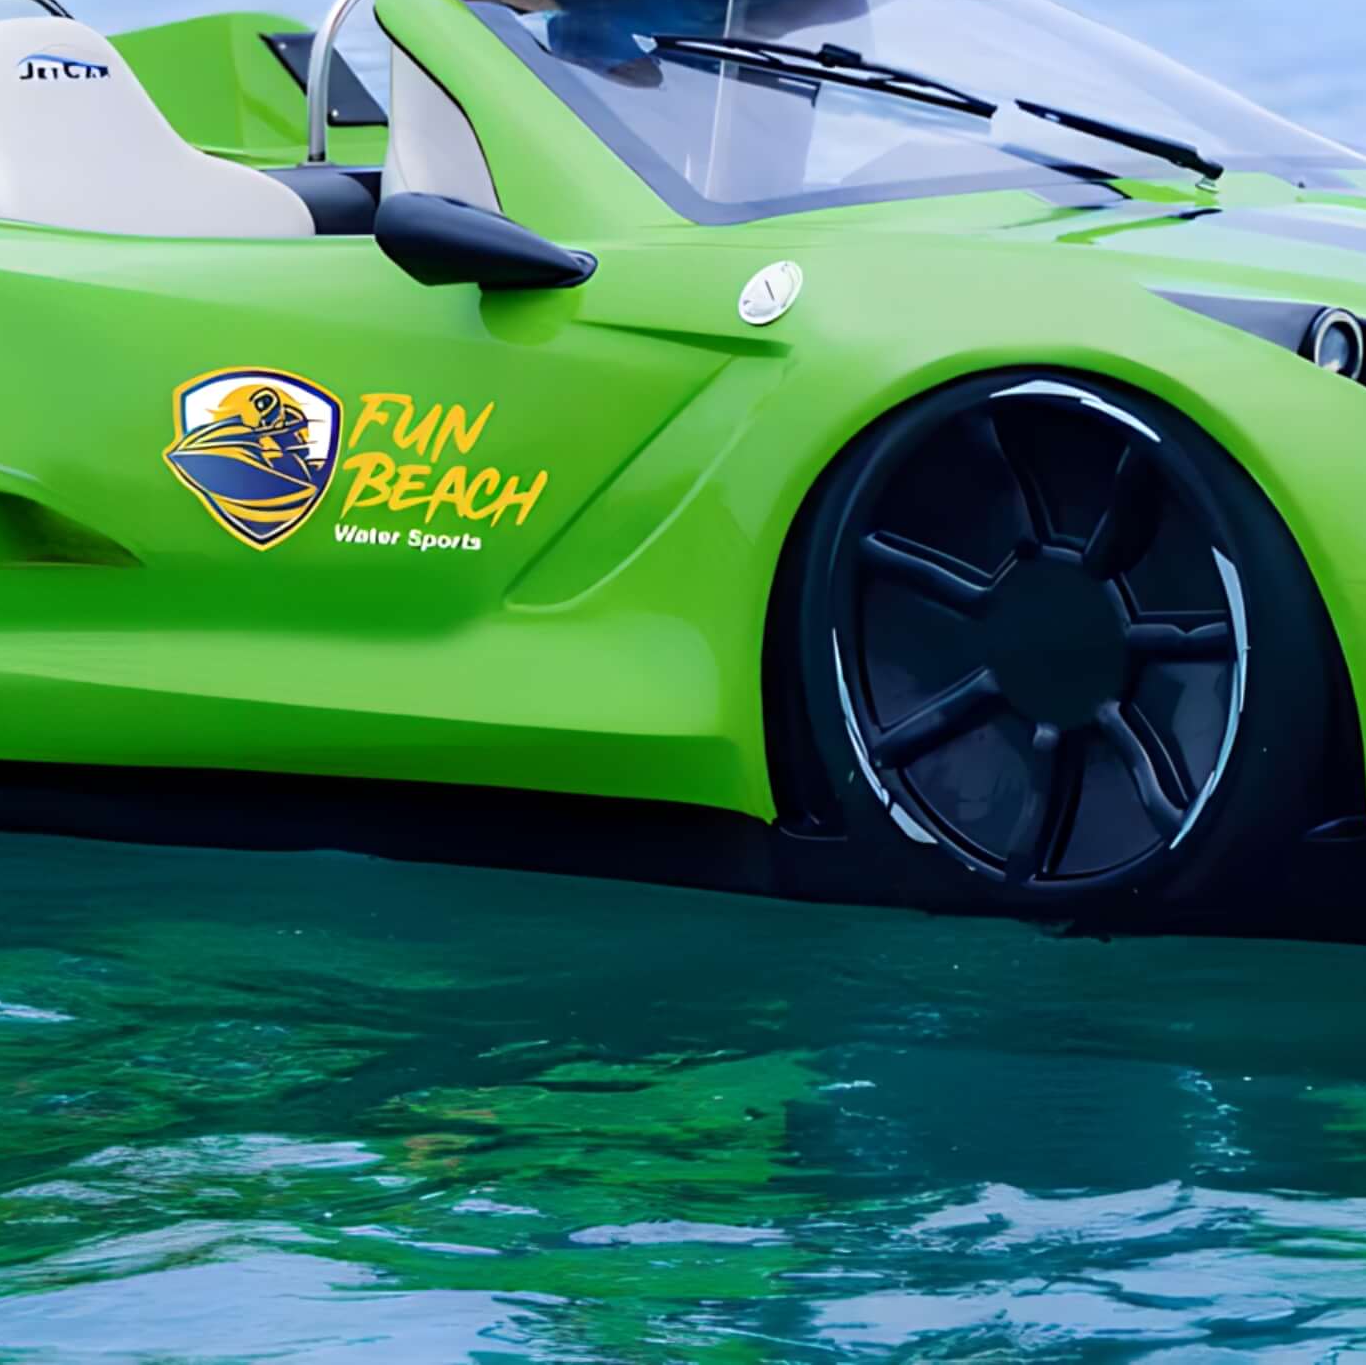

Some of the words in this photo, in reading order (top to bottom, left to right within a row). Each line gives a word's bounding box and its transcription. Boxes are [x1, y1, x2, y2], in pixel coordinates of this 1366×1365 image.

[347, 392, 495, 463] FUN
[340, 451, 548, 528] BEACH
[334, 523, 400, 545] Water
[407, 528, 482, 552] Sports
